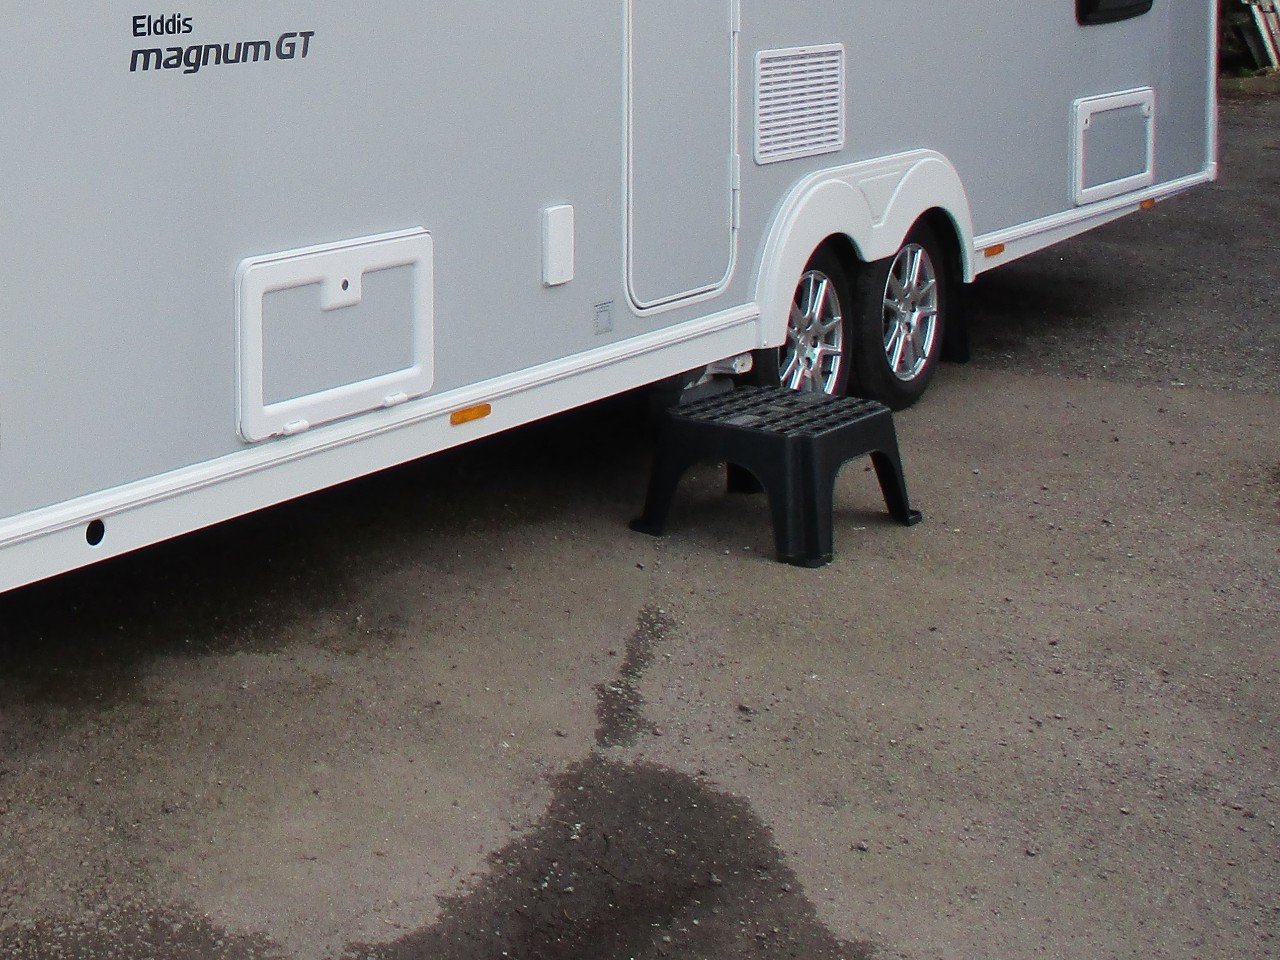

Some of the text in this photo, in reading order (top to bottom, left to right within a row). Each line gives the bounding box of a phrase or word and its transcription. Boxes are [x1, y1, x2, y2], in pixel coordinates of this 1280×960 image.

[132, 13, 193, 37] Elddis
[129, 30, 315, 75] magnum GT
